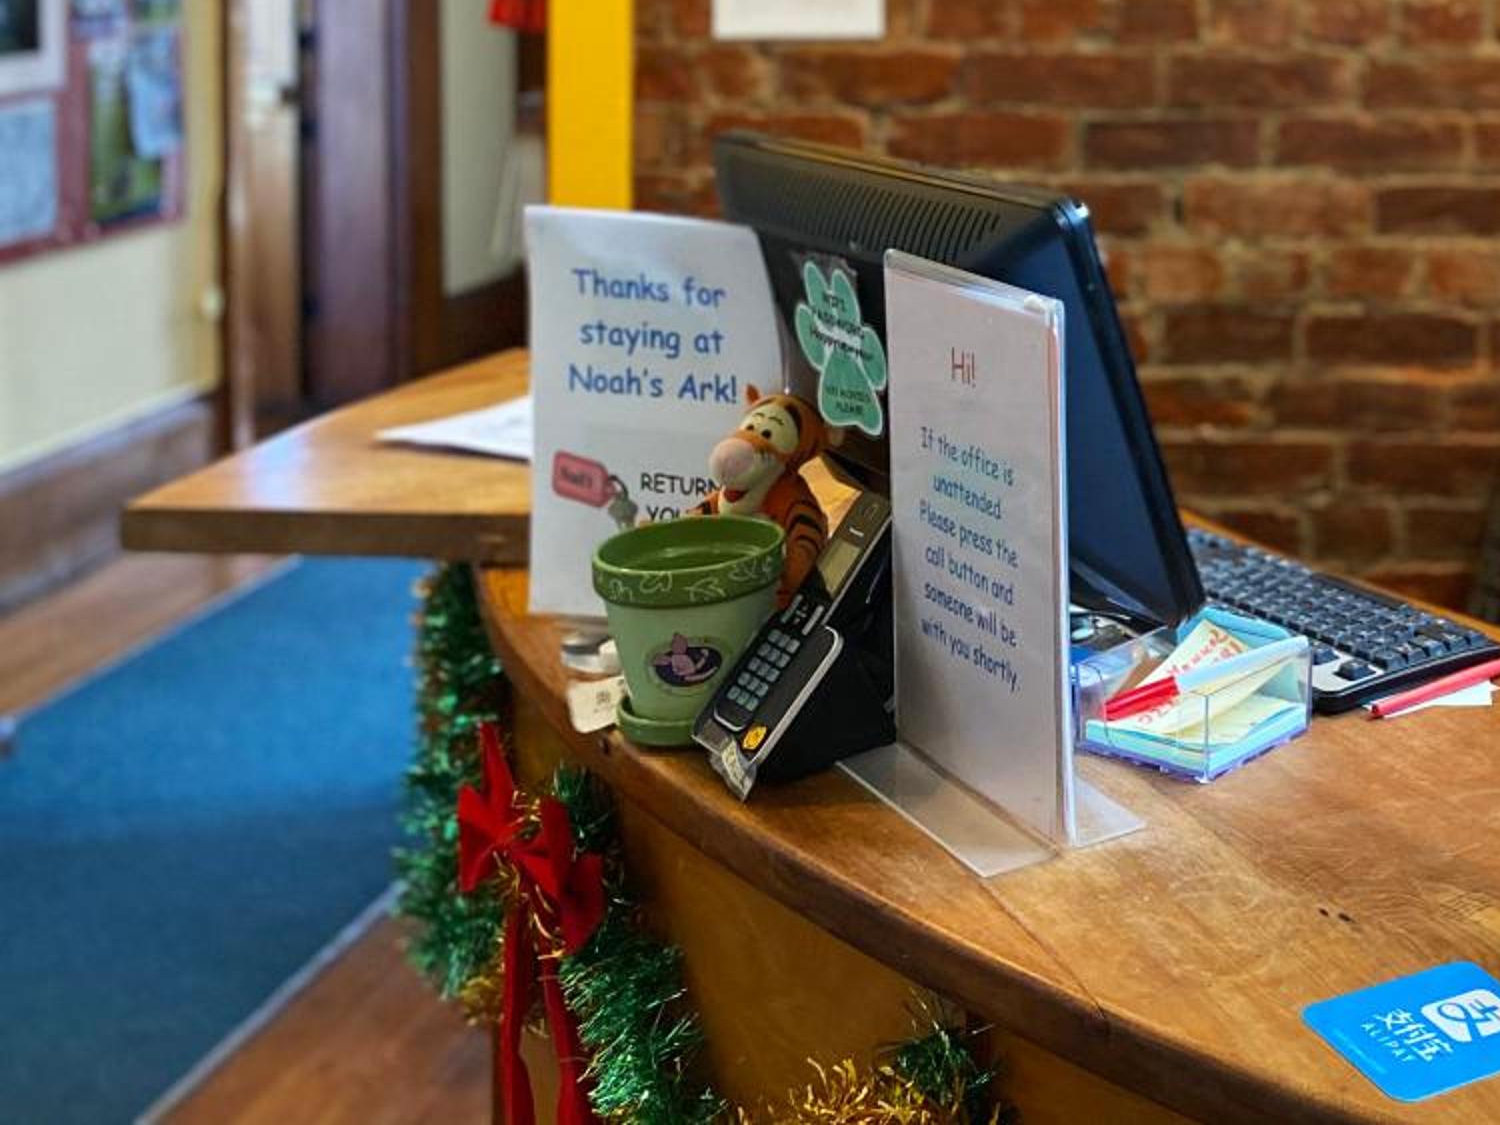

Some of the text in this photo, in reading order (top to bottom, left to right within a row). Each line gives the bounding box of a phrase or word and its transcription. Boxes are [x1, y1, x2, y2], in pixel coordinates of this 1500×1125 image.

[571, 267, 727, 308] Thanks for
[579, 319, 725, 360] staying at
[568, 363, 738, 405] Noah's Ark!
[951, 346, 977, 388] Hi!
[920, 425, 1016, 487] If the office is
[933, 474, 1003, 520] unattended
[920, 498, 1019, 569] Please press the
[925, 545, 1014, 606] call button and
[924, 582, 1017, 648] someone will be
[920, 617, 947, 646] with
[948, 633, 971, 660] you
[1363, 1022, 1417, 1063] ALIPAY
[1373, 1008, 1454, 1062] 支付宝
